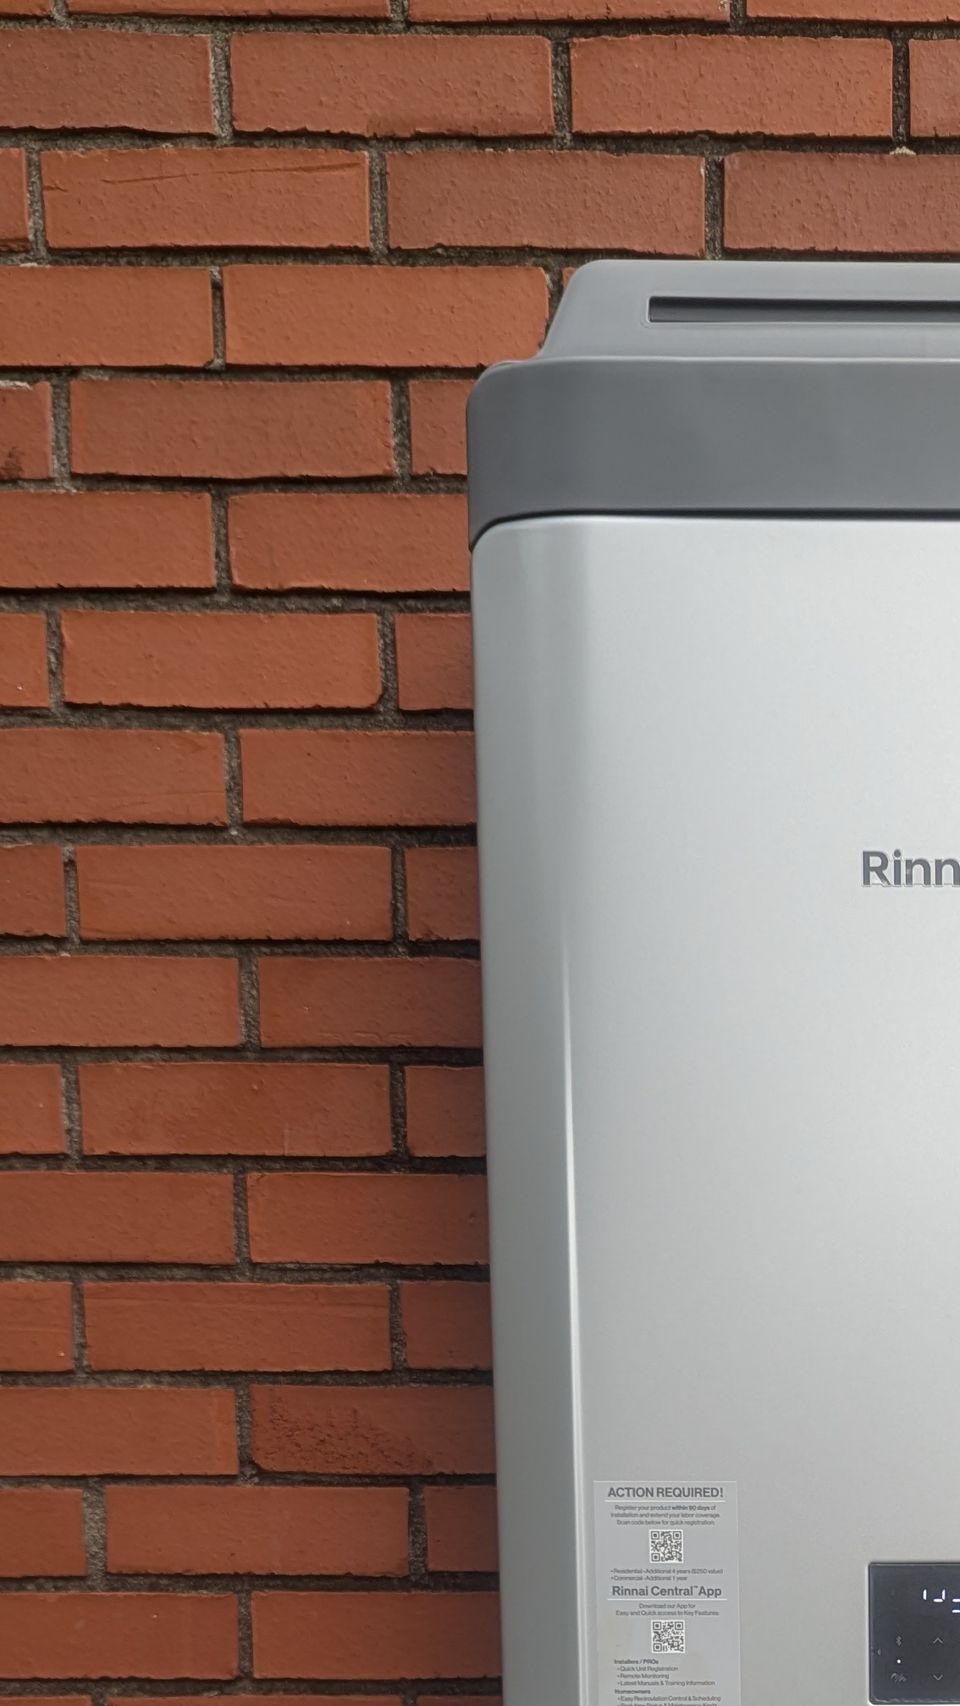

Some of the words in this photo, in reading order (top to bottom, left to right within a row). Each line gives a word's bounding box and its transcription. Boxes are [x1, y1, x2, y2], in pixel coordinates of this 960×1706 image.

[608, 1487, 654, 1497] ACTION
[656, 1487, 723, 1498] REQUIRED!
[612, 1585, 648, 1596] Rinnai
[698, 1585, 722, 1598] App
